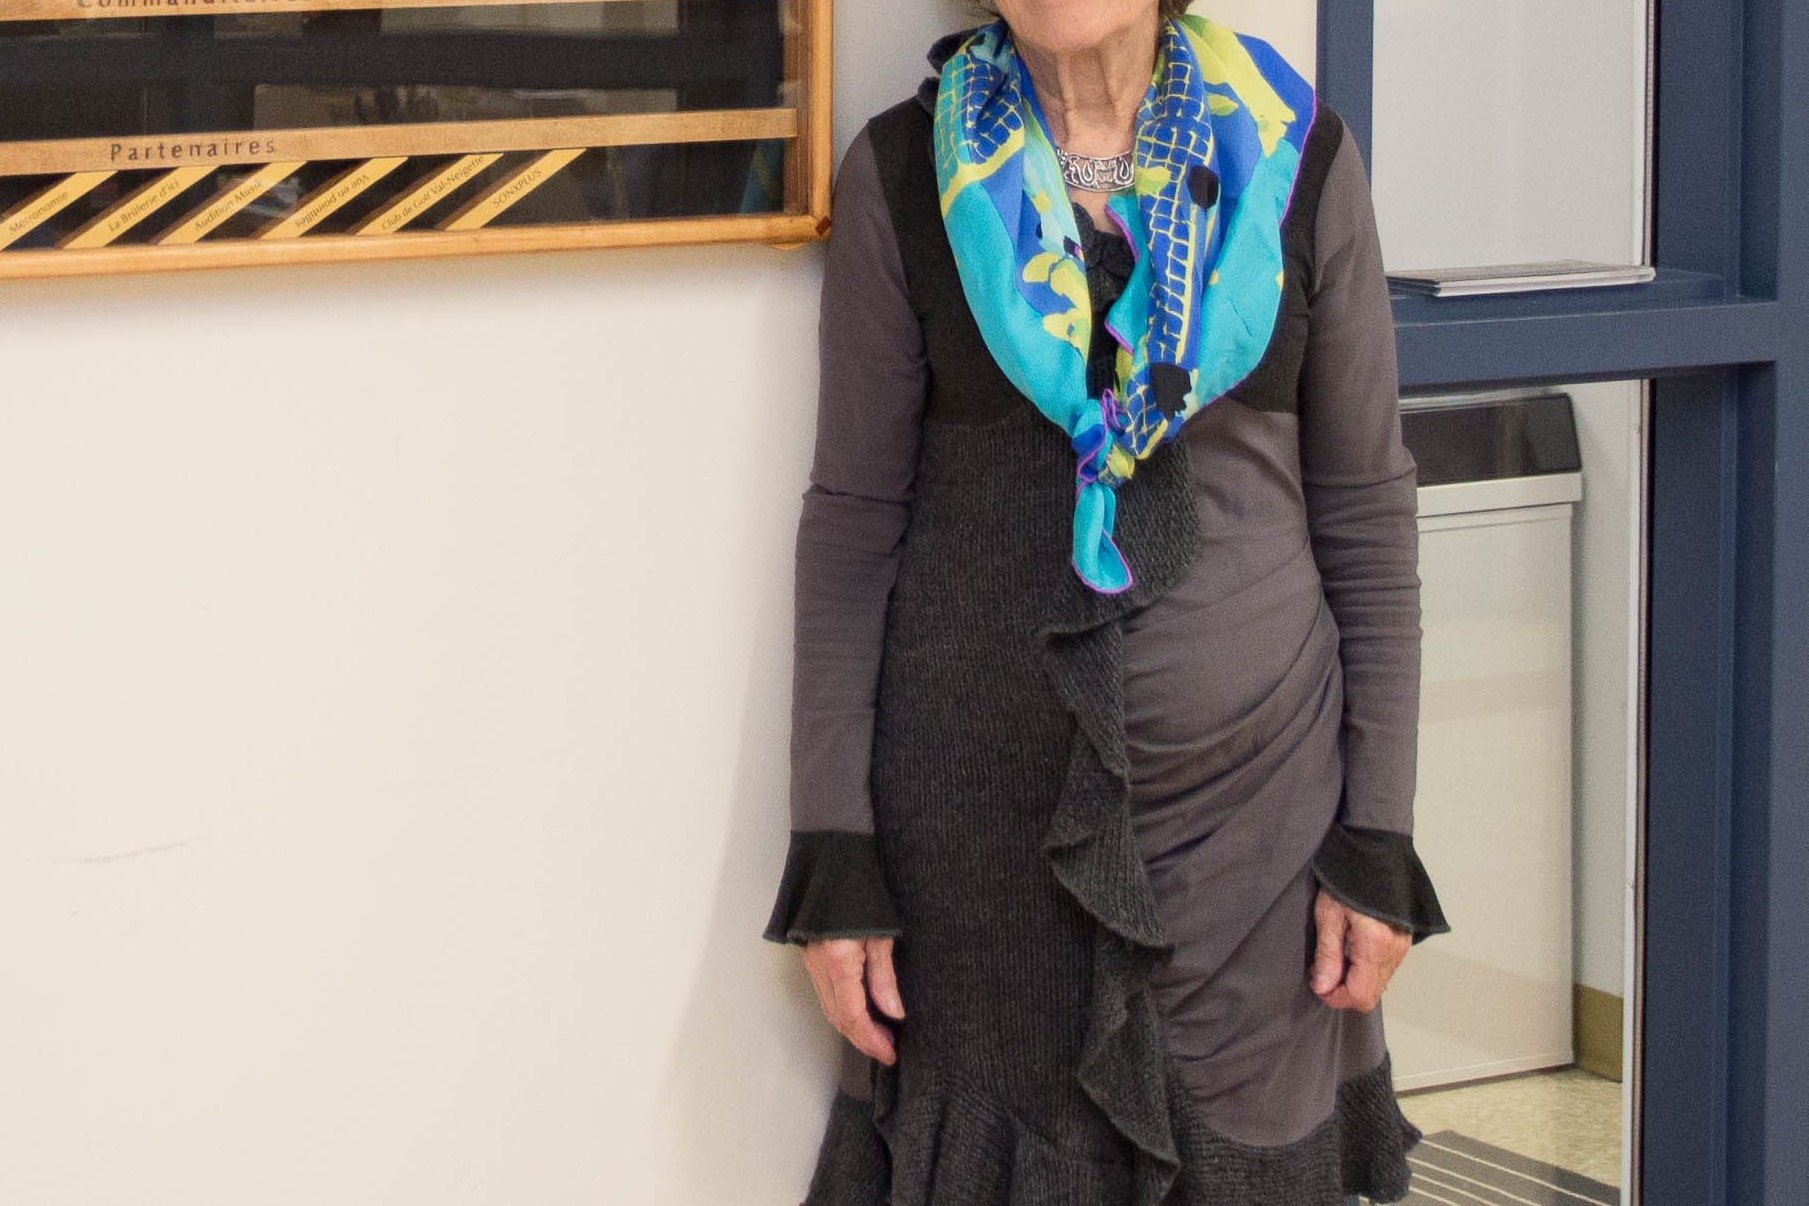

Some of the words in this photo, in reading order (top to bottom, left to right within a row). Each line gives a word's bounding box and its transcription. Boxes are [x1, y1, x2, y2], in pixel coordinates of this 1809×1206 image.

[110, 136, 276, 162] Partenaires
[193, 202, 234, 232] Audition
[381, 214, 402, 231] Club
[402, 205, 413, 217] de
[413, 192, 431, 211] Golf
[108, 221, 121, 233] La
